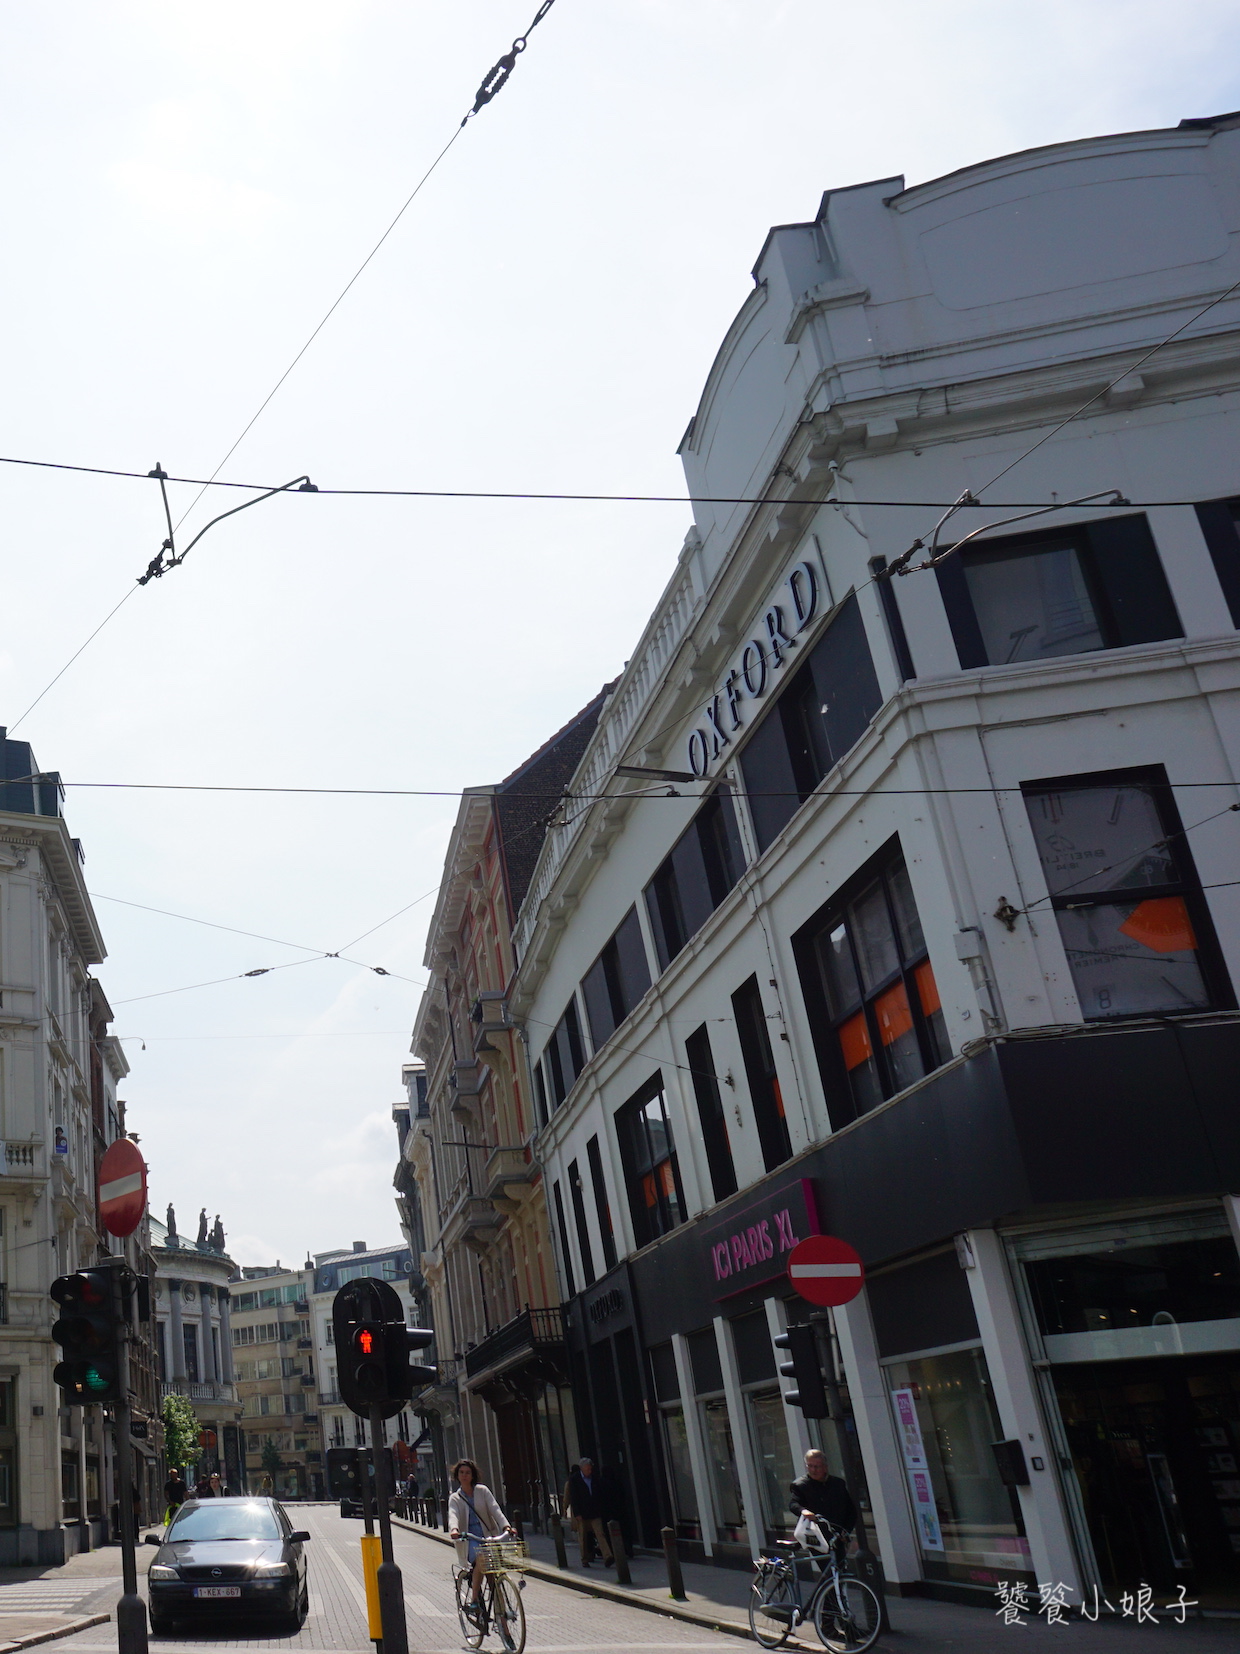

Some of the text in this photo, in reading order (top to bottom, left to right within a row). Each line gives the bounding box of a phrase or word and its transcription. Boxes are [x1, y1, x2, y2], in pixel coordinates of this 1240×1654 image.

[688, 561, 817, 777] OXFORD
[711, 1208, 800, 1281] ICI PARIS XL
[865, 1562, 875, 1575] 5
